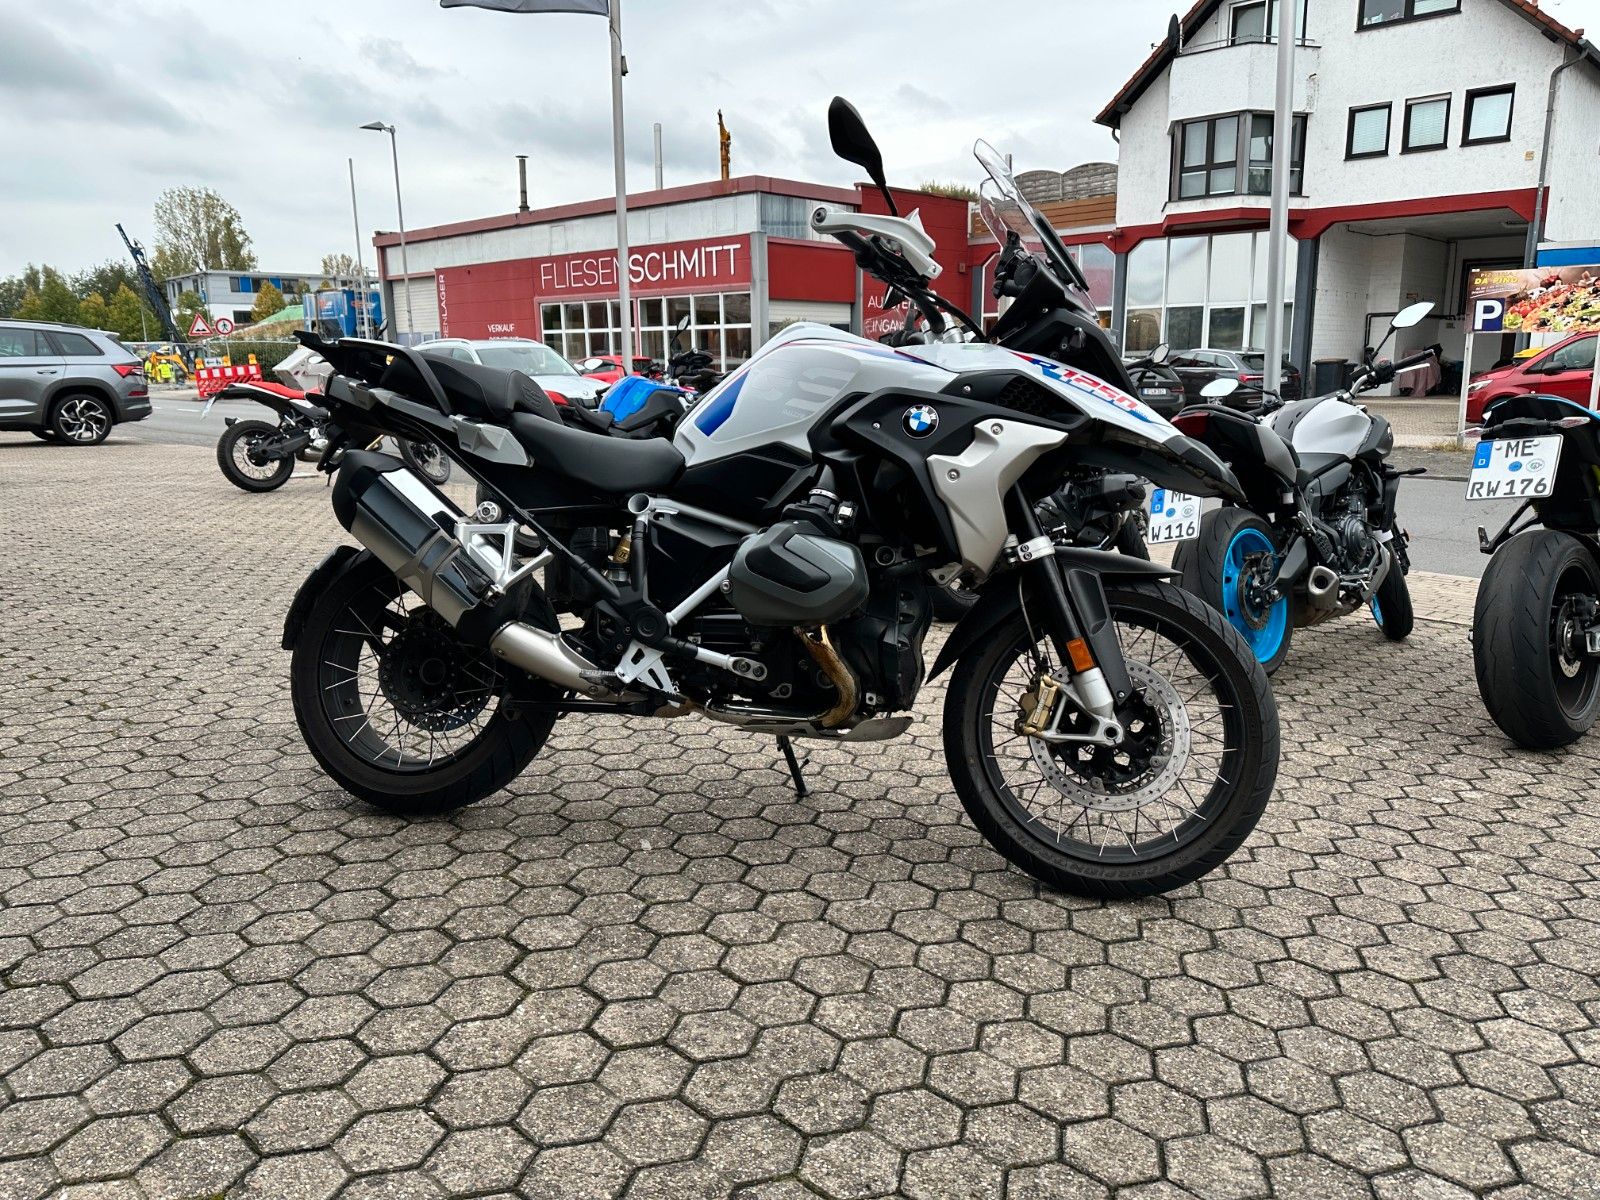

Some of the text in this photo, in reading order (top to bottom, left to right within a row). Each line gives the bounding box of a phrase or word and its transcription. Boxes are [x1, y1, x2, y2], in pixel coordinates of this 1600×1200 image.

[1474, 300, 1503, 330] P
[487, 323, 516, 333] VERKAUF
[1505, 440, 1535, 458] ME
[1478, 458, 1486, 466] D
[1164, 521, 1196, 540] 116
